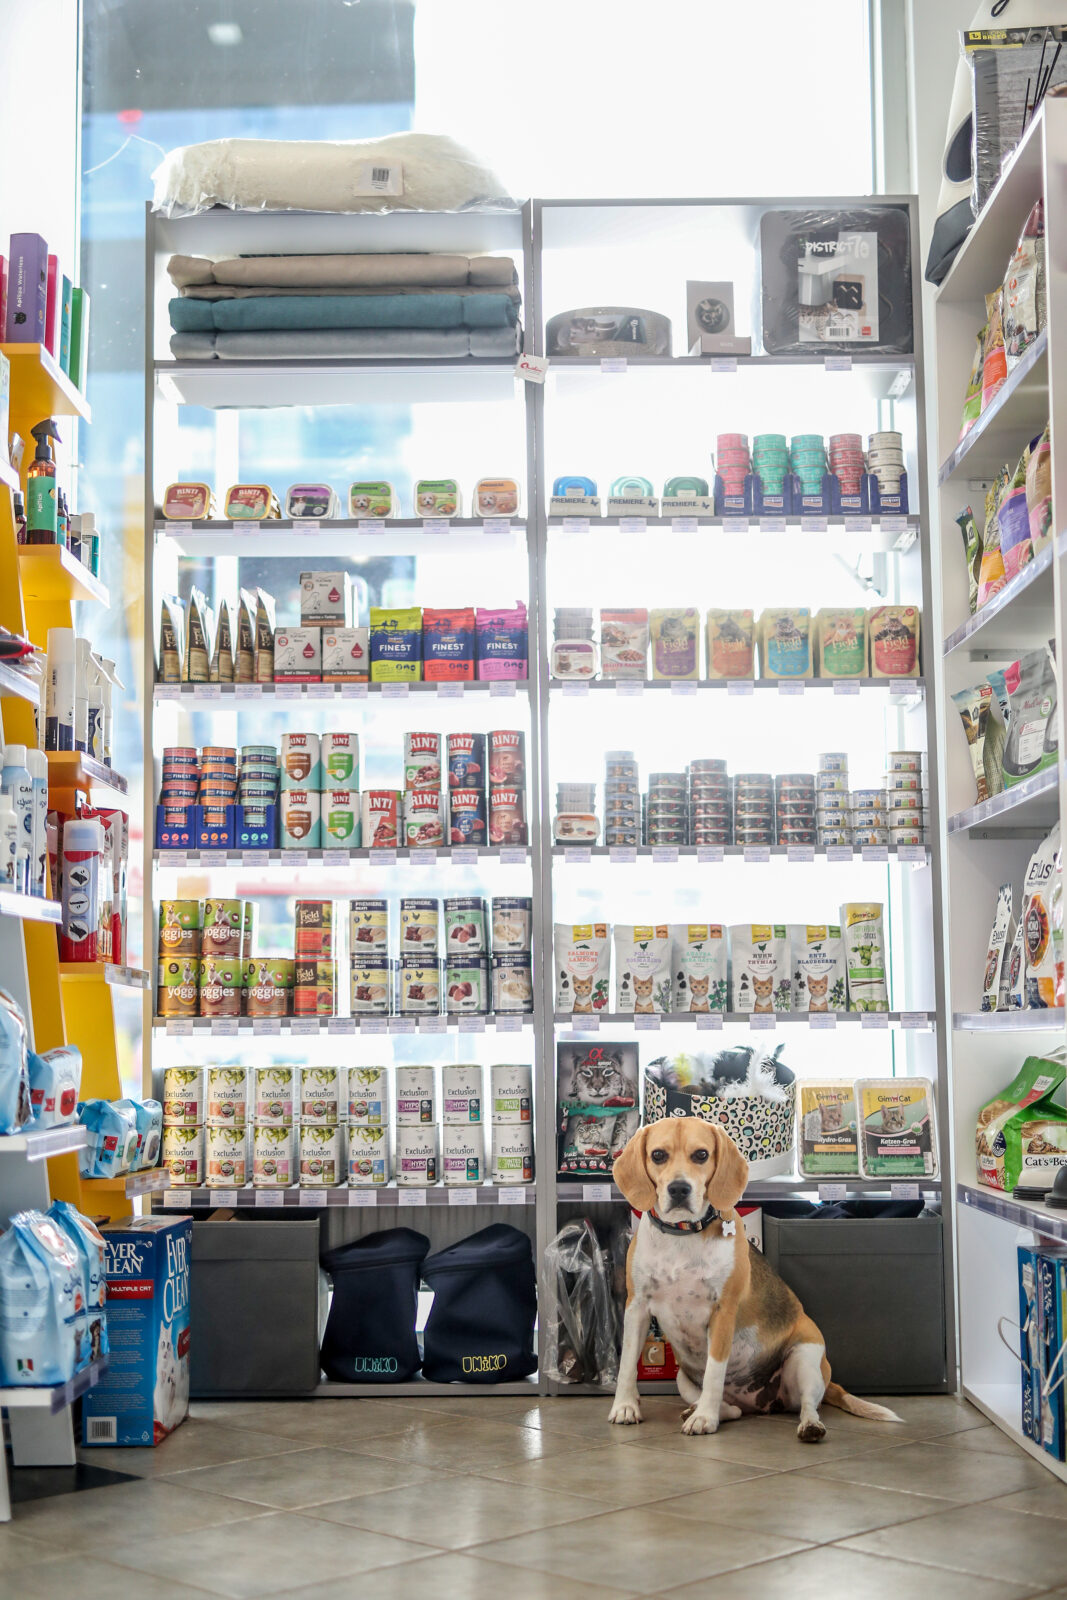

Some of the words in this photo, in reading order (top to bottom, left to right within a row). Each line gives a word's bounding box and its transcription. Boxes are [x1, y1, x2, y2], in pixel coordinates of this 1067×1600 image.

[486, 642, 518, 650] FINEST
[449, 738, 474, 748] RINTI
[492, 734, 519, 745] RINTI
[451, 794, 479, 805] RINTI
[490, 792, 518, 803] RINTI
[160, 930, 193, 941] oggies
[203, 928, 240, 942] yoggies
[447, 1088, 476, 1096] Exclusion
[498, 1087, 527, 1095] Exclusion
[880, 1138, 916, 1146] Katzen-Gras
[1024, 1156, 1048, 1166] Cat's
[1053, 1157, 1067, 1166] Bes
[104, 1239, 144, 1262] EVER
[166, 1233, 190, 1279] EVER
[106, 1259, 142, 1275] LEAN
[163, 1270, 190, 1324] CLEAN
